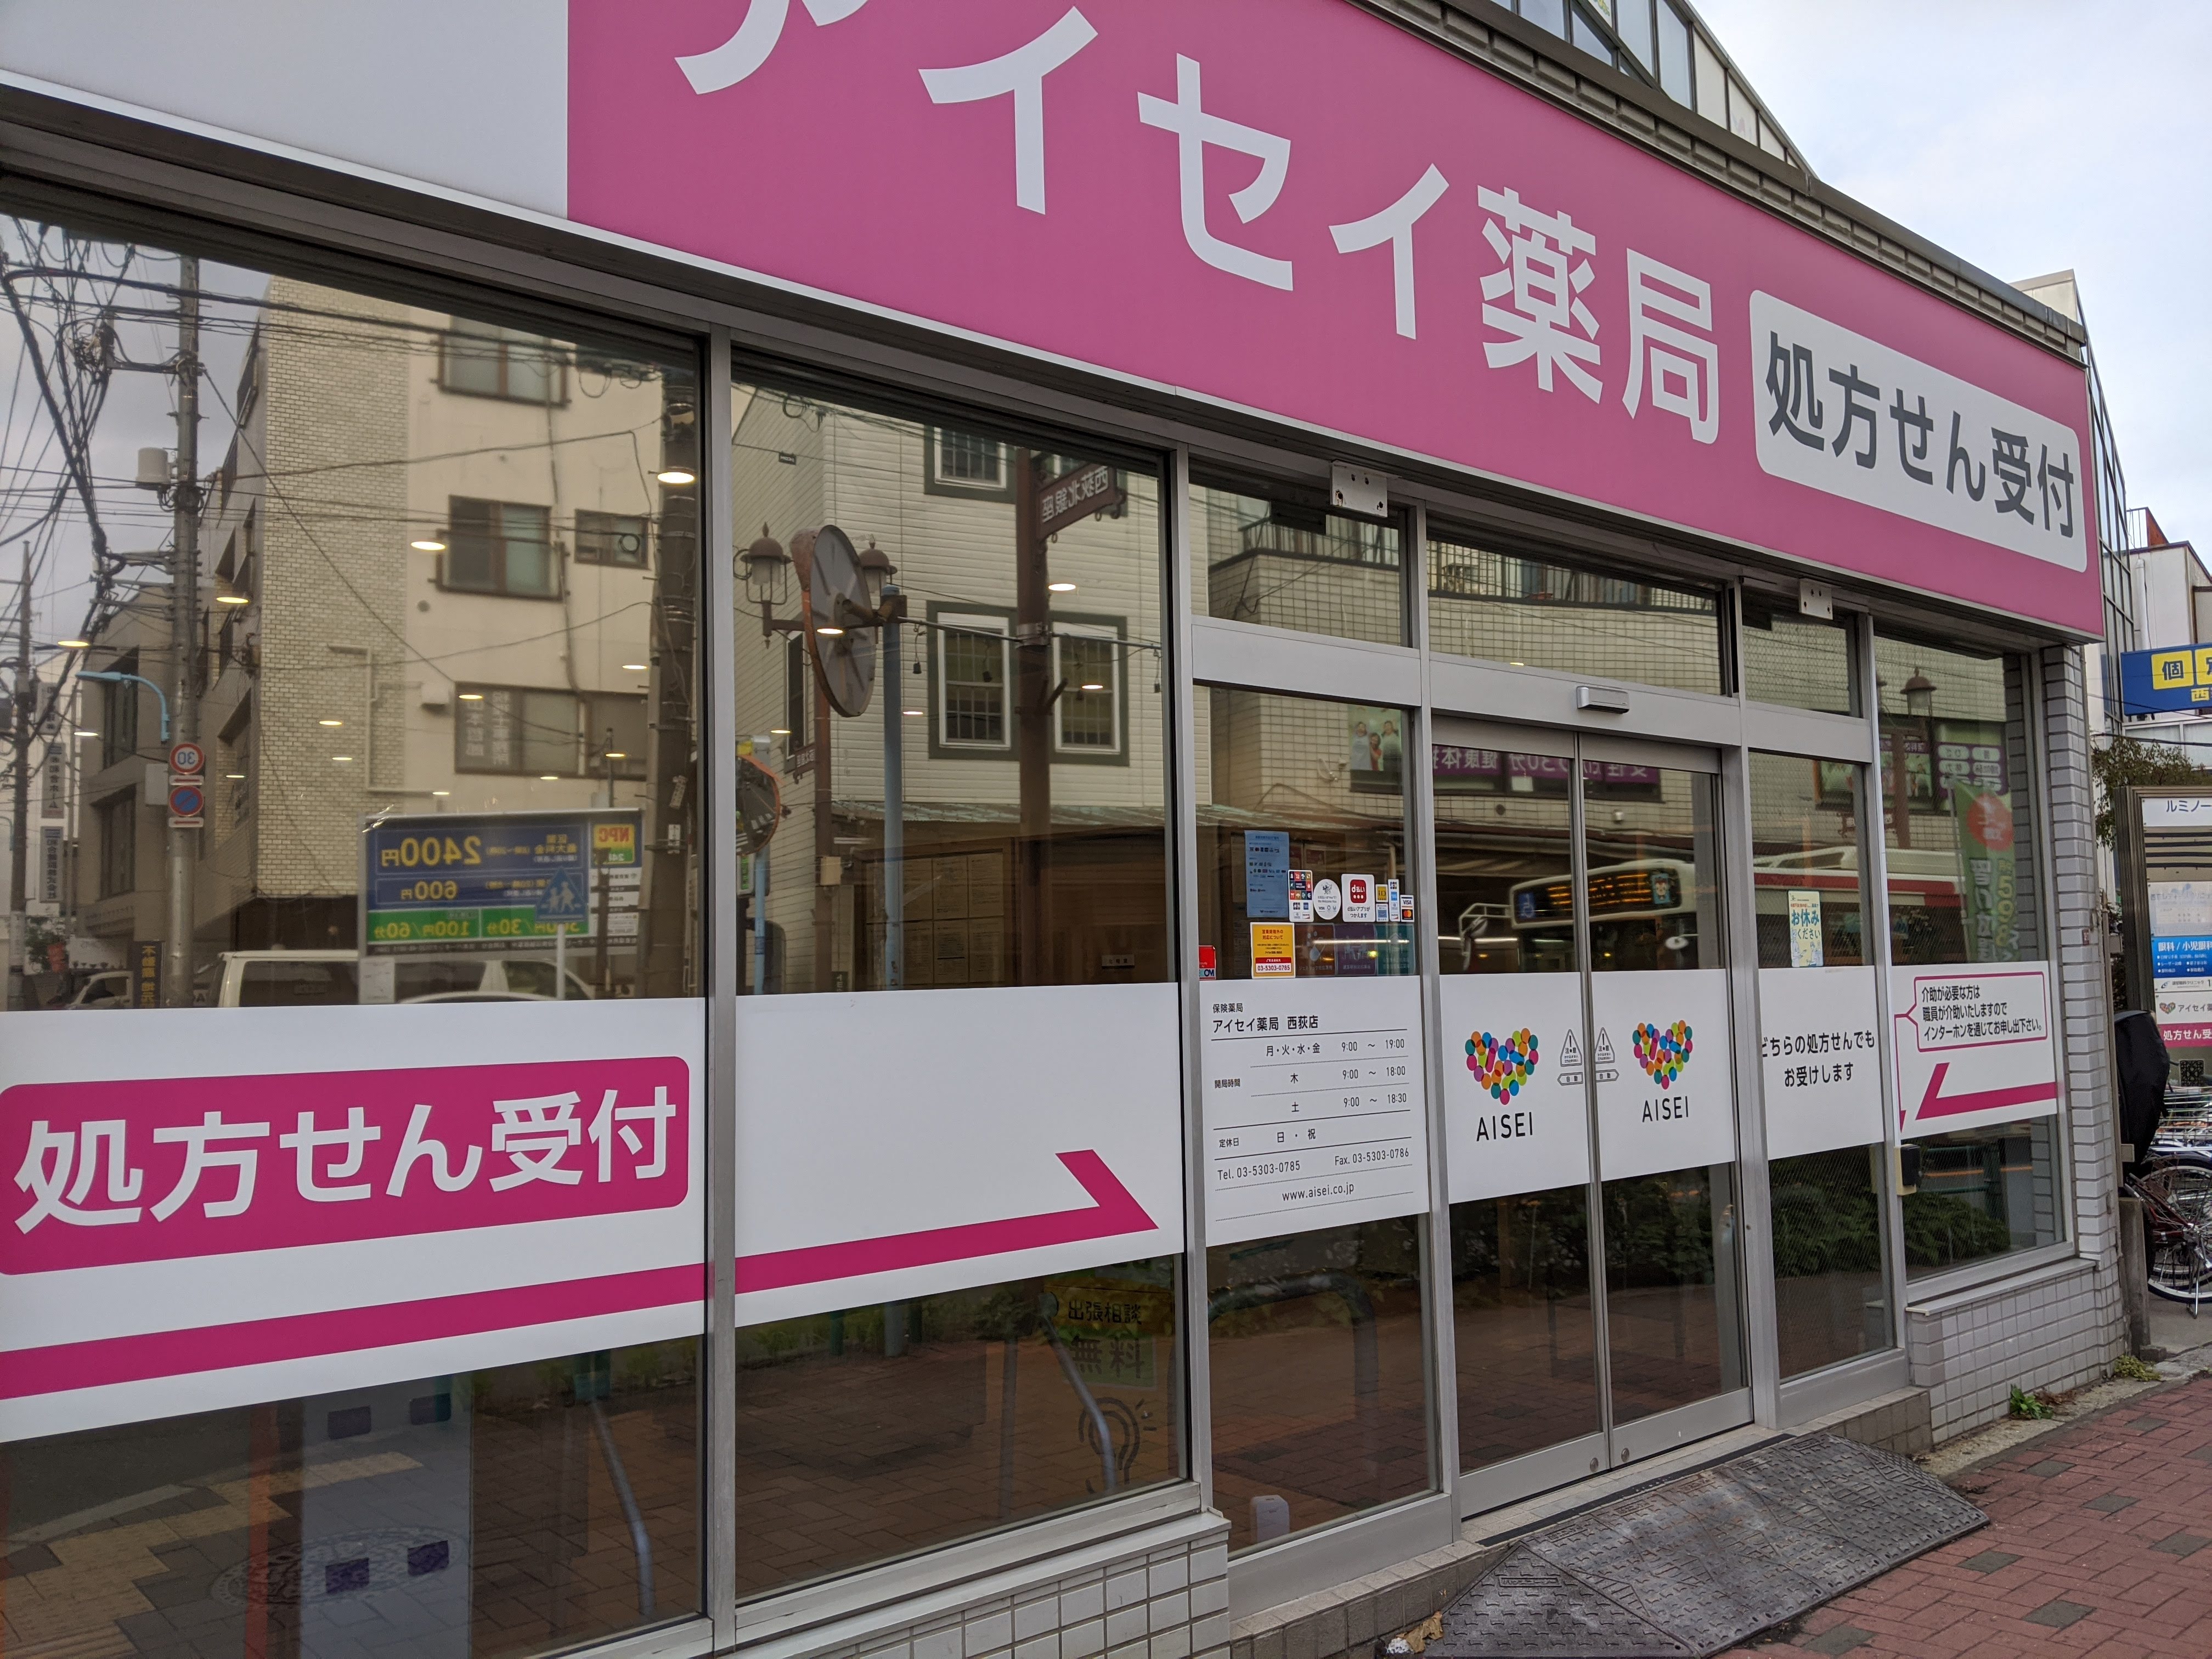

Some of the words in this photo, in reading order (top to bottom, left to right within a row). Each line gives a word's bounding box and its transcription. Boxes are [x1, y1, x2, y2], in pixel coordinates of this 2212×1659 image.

[1765, 331, 2074, 539] 処方せん受付
[1351, 885, 1365, 893] d払い
[1791, 907, 1820, 927] お休み
[1797, 928, 1821, 940] ください
[2158, 941, 2174, 952] 眼科
[1922, 985, 1980, 1003] 介助が必要な方は
[1212, 1003, 1243, 1014] 保険薬局
[1923, 1002, 2007, 1022] 職員が介助いたしますので
[1213, 1017, 1279, 1033] アイセイ薬局
[1287, 1015, 1319, 1030] 西荻店
[1923, 1018, 2042, 1041] インターホンを通じてお申し出下さい。
[2163, 1029, 2212, 1041] 処方せん受
[1266, 1042, 1321, 1057] 月・火・水・金
[1341, 1041, 1358, 1052] 9:00
[1385, 1039, 1405, 1049] 19:00
[1214, 1078, 1241, 1089] 開局時間
[1290, 1073, 1299, 1084] 木
[1342, 1069, 1359, 1080] 9:00
[1386, 1066, 1406, 1077] 18:00
[1784, 1062, 1854, 1087] お受けします
[1291, 1101, 1300, 1113] 土
[1343, 1097, 1360, 1108] 9:00
[1387, 1093, 1407, 1104] 18:30
[1641, 1096, 1689, 1123] AISEI
[1476, 1111, 1533, 1142] AISEI
[1218, 1137, 1239, 1148] 定休日
[14, 1085, 676, 1234] 処方せん受付
[1334, 1155, 1351, 1166] Fax.
[1352, 1148, 1409, 1164] 03-5303-0786
[1217, 1169, 1234, 1181] Tel.
[1236, 1160, 1301, 1178] 03-5303-0785
[1282, 1182, 1355, 1201] www.aisei.co.jp
[1068, 1300, 1142, 1325] 出張相談
[1071, 1335, 1145, 1379] 無料
